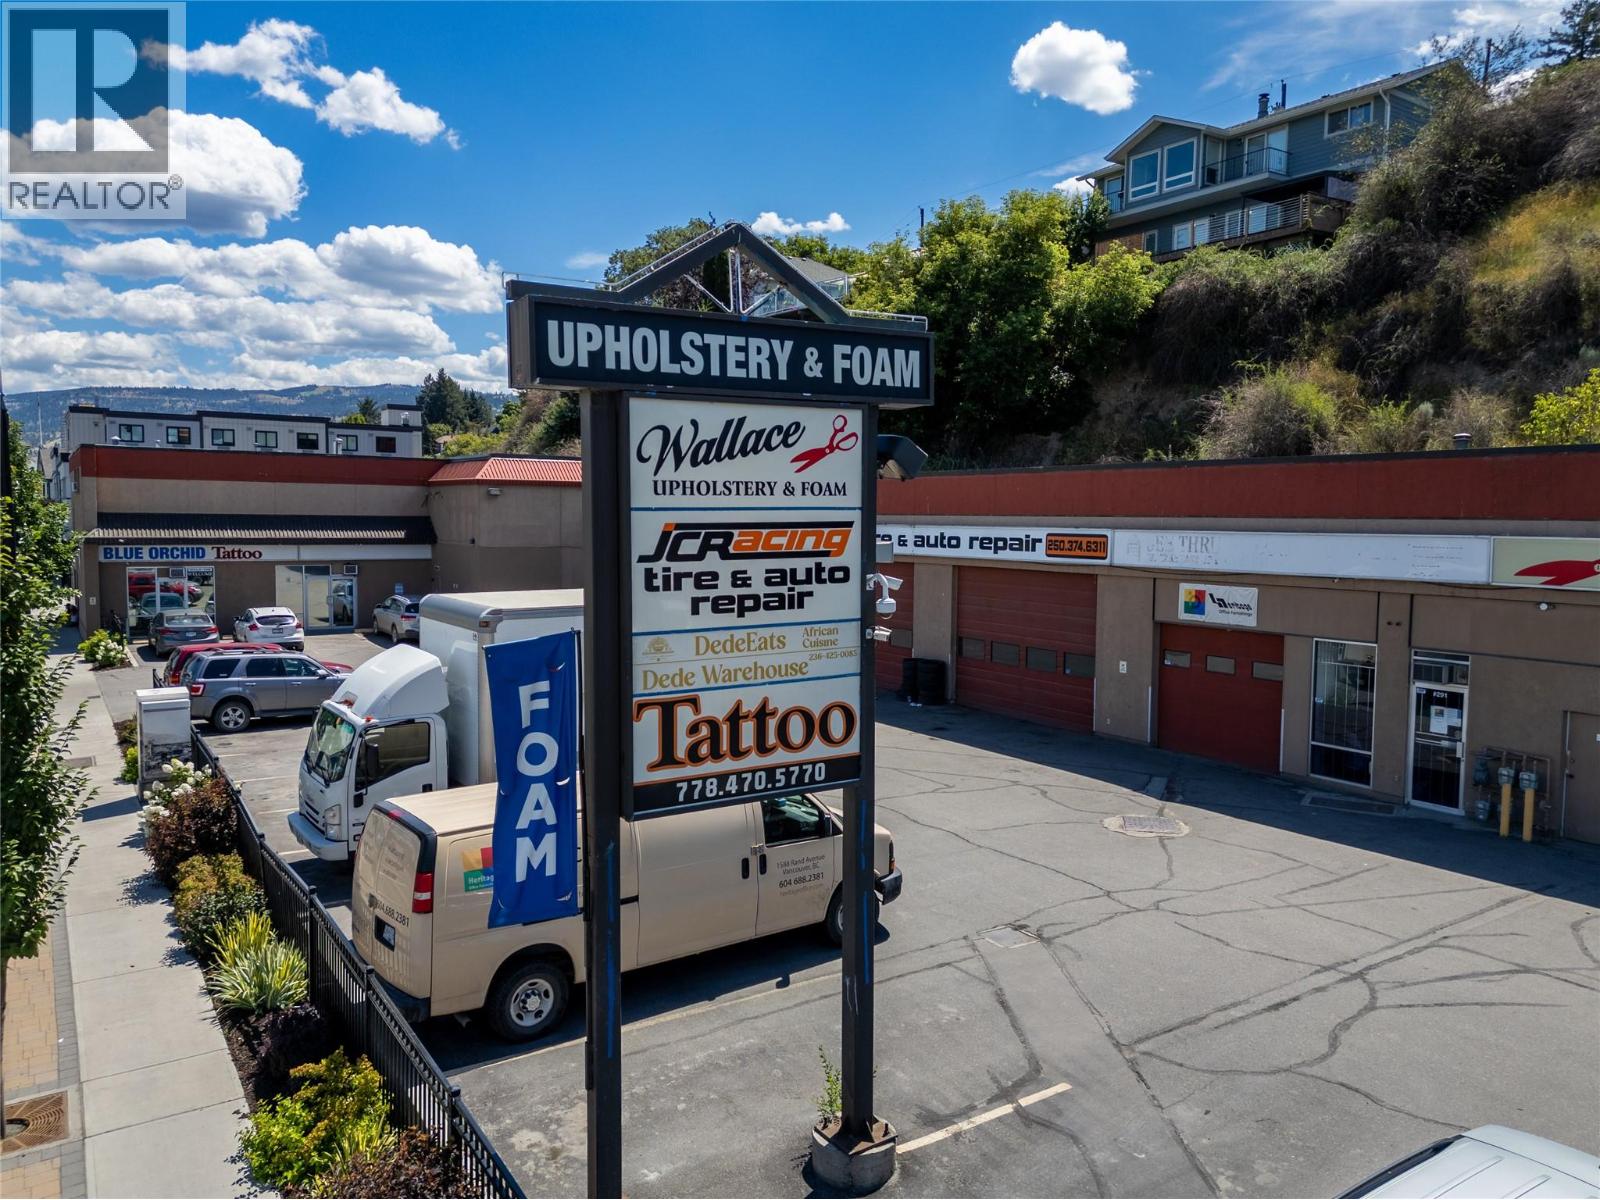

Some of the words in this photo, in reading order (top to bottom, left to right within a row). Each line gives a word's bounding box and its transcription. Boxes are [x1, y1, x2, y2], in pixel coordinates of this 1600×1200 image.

[547, 319, 794, 381] UPHOLSTERY
[803, 346, 823, 378] &
[833, 344, 920, 388] FOAM
[636, 415, 806, 477] Wallace
[653, 479, 778, 497] UPHOLSTERY
[783, 481, 795, 497] &
[800, 481, 847, 497] FOAM
[103, 546, 144, 560] BLUE
[149, 546, 206, 560] ORCHID
[211, 546, 262, 560] Tattoo
[897, 534, 908, 547] &
[913, 531, 961, 549] auto
[968, 533, 1042, 554] repair
[1047, 539, 1107, 554] 250.374.6311
[644, 567, 719, 592] tire
[731, 568, 752, 587] &
[764, 562, 850, 587] auto
[691, 588, 814, 618] repair
[694, 631, 787, 657] DedeEats
[802, 626, 839, 638] African
[802, 637, 839, 649] Cuisine
[642, 668, 695, 691] Dede
[701, 661, 809, 685] Warehouse
[633, 694, 858, 773] Tattoo
[515, 680, 559, 883] FOAM
[676, 762, 826, 802] 778.470.5770
